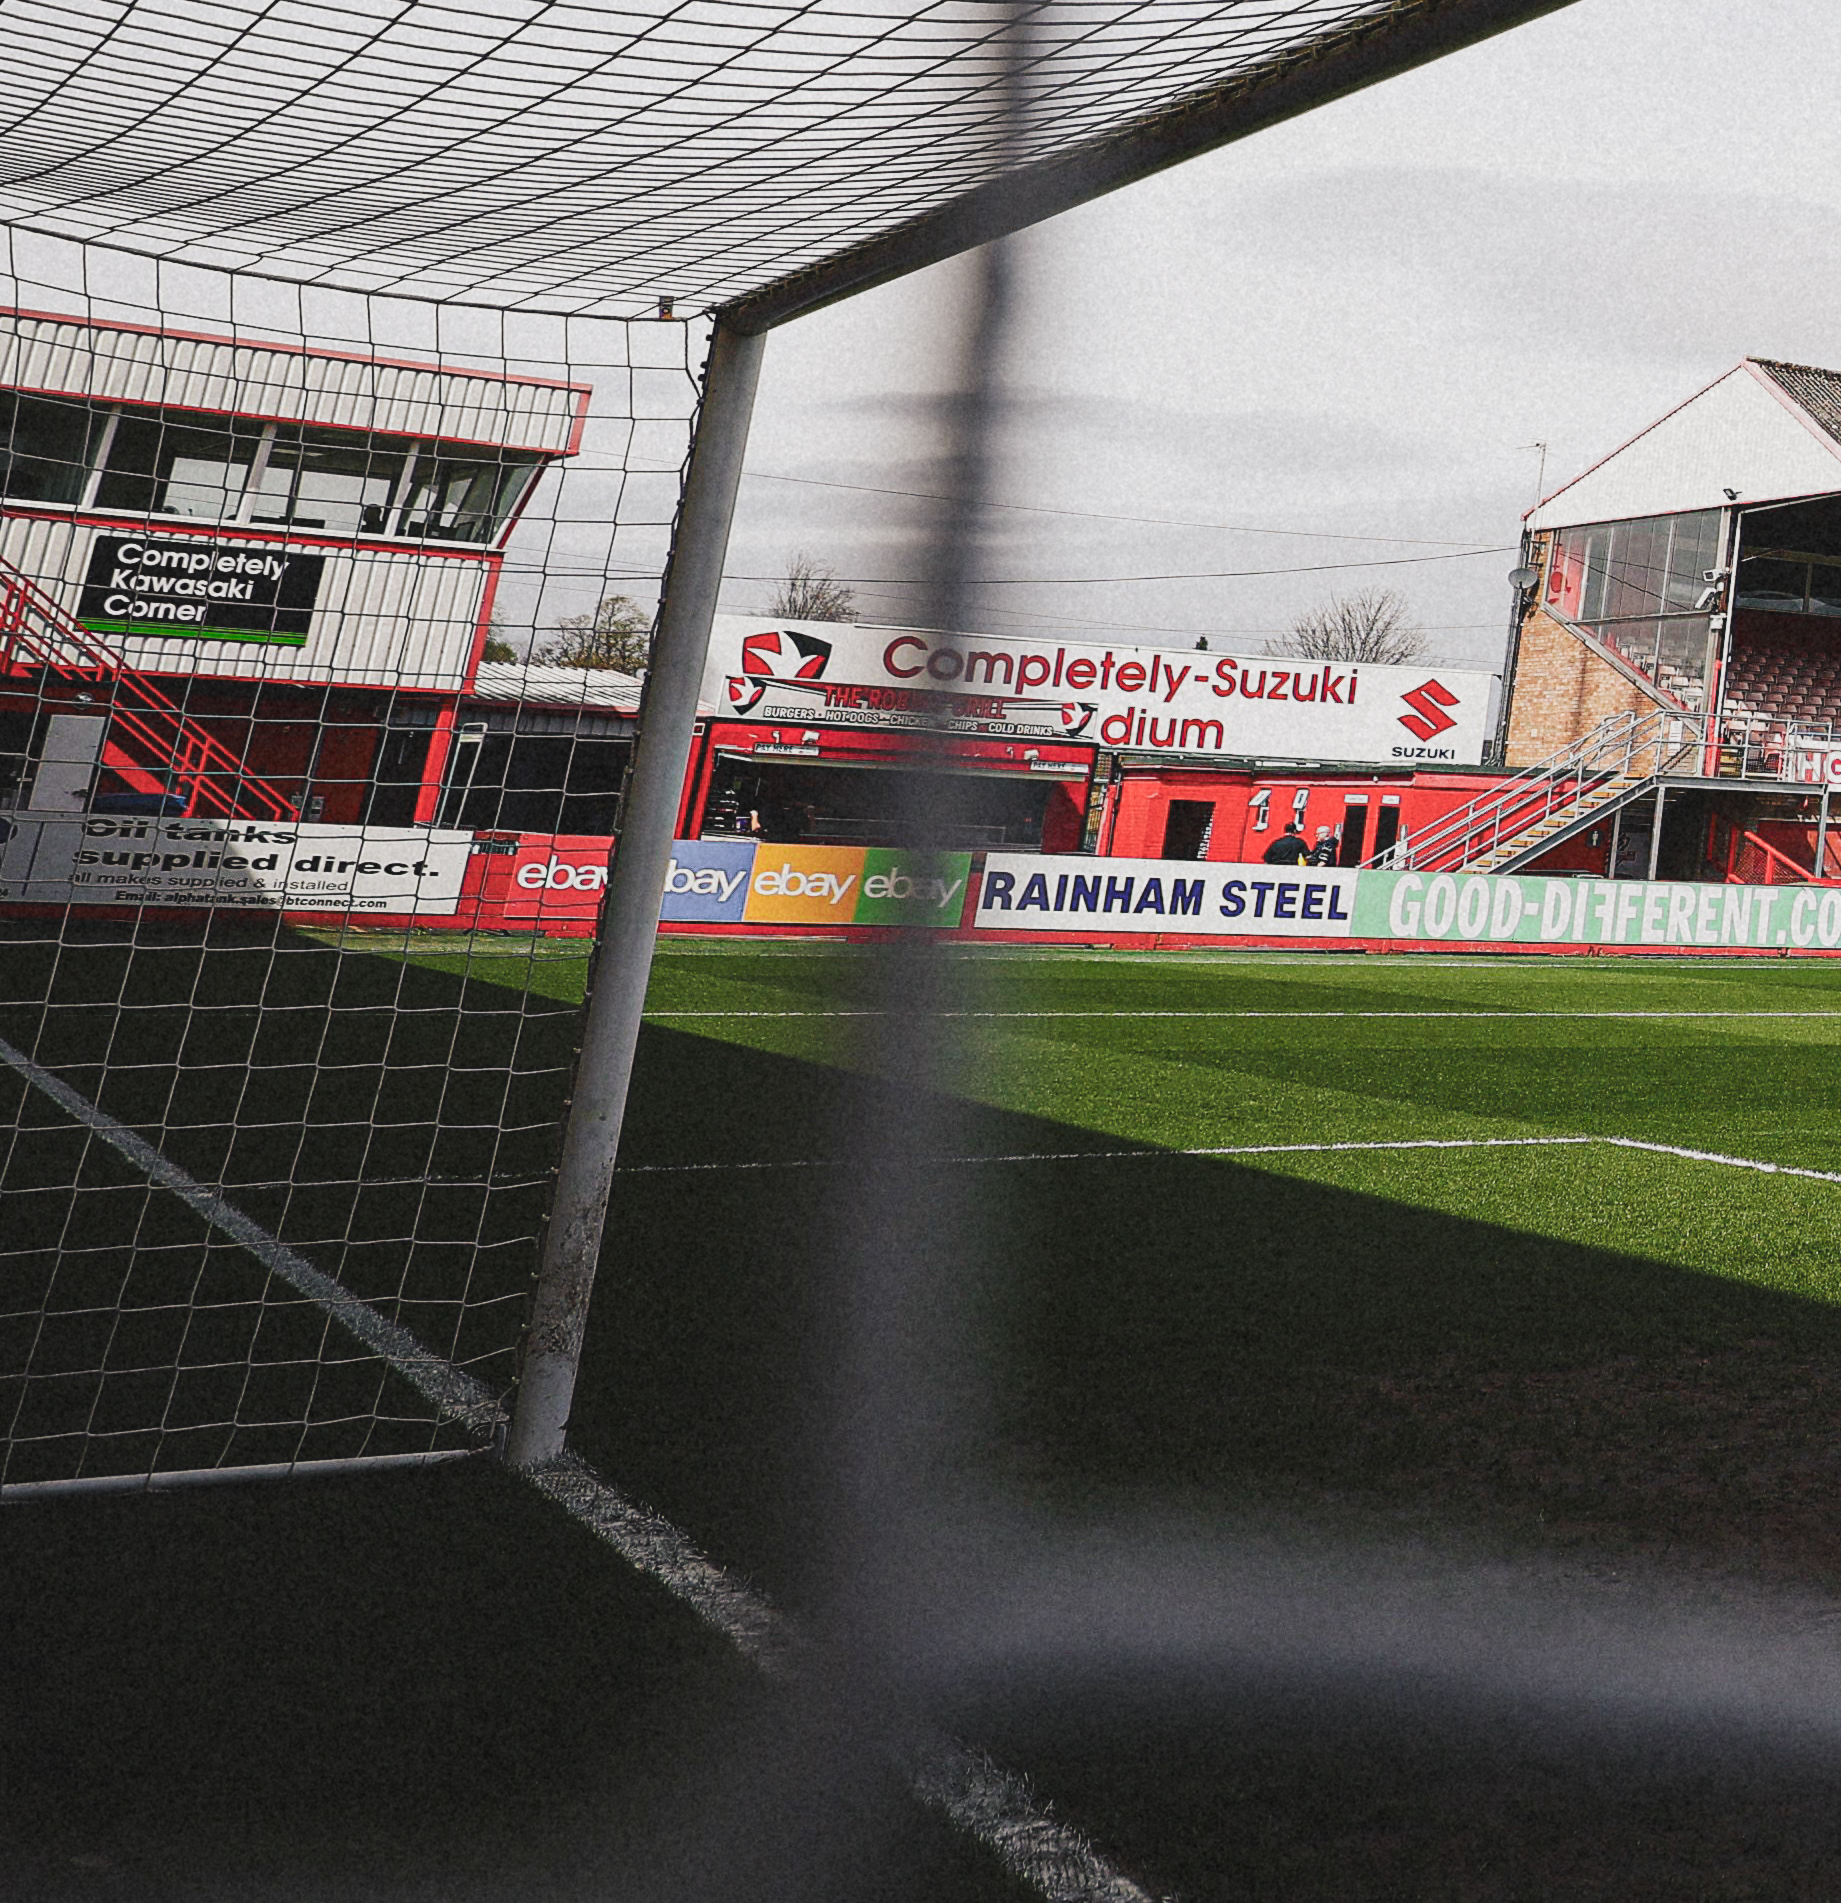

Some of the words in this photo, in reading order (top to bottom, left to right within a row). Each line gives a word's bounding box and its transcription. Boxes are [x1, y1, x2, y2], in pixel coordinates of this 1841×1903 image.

[117, 543, 290, 581] Completely
[110, 568, 254, 600] Kawasaki
[104, 594, 206, 622] Corner
[883, 636, 1359, 705] Completely-Suzuki
[824, 685, 863, 708] THE
[763, 706, 815, 720] BURGERS
[890, 714, 929, 726] CHICKE
[949, 720, 979, 731] CHIPS
[988, 722, 1015, 733] COLD
[1016, 724, 1053, 736] DRINKS
[1101, 706, 1224, 750] dium
[1391, 746, 1456, 760] SUZUKI
[84, 818, 149, 839] Oil
[165, 822, 297, 845] tanks
[72, 849, 279, 872] supplied
[294, 855, 440, 877] direct.
[517, 855, 608, 891] eba
[97, 873, 162, 886] makes
[168, 875, 248, 889] supplied
[253, 878, 266, 889] &
[273, 878, 349, 891] installed
[115, 890, 161, 902] Email:
[664, 859, 746, 902] bay
[754, 863, 856, 905] ebay
[864, 866, 962, 908] eby
[982, 871, 1206, 916] RAINHAM
[1220, 879, 1348, 921] STEEL
